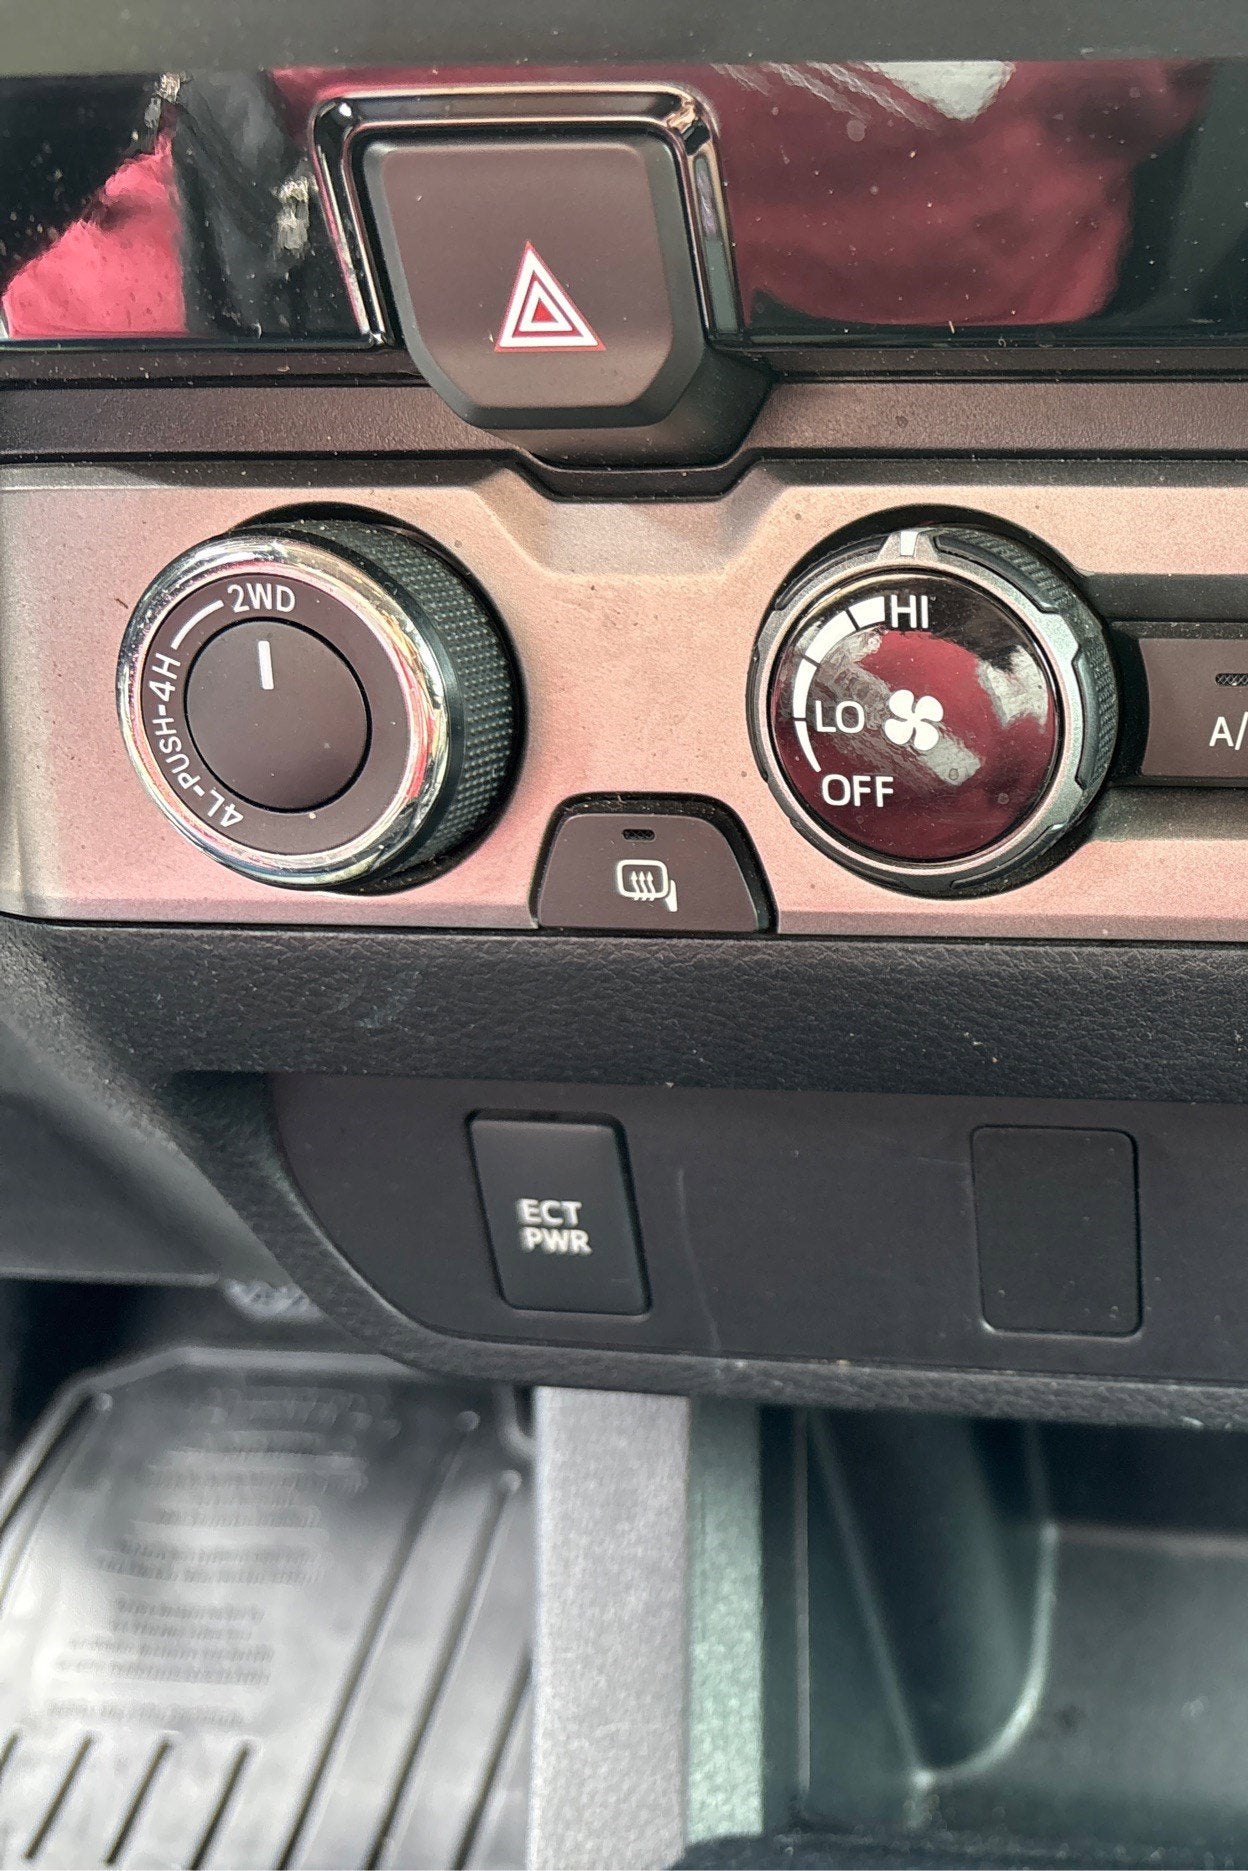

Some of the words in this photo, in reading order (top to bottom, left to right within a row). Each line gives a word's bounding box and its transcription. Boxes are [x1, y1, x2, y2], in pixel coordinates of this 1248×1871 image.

[228, 583, 295, 613] 2WD
[891, 594, 928, 628] HI
[815, 700, 865, 733] LO
[821, 773, 894, 807] OFF
[517, 1198, 582, 1228] ECT
[520, 1226, 593, 1256] PWR
